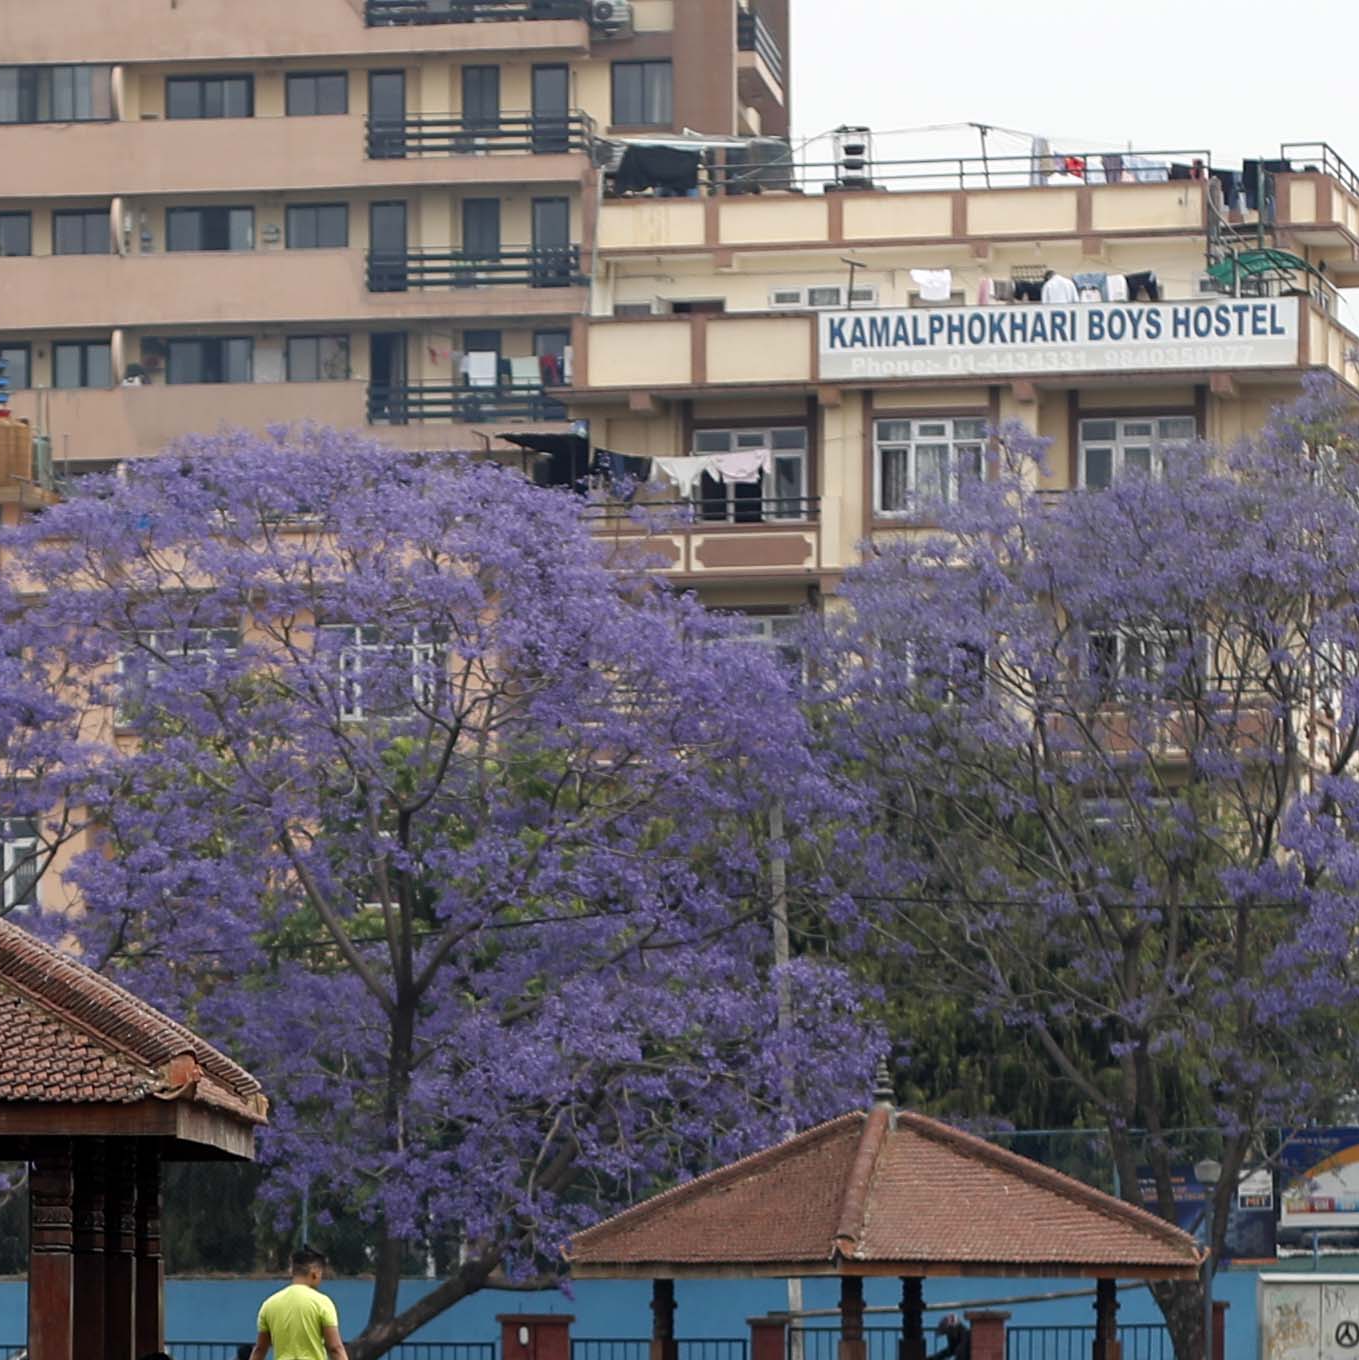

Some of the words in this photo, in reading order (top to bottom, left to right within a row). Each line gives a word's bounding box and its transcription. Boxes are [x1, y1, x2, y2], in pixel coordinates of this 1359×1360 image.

[828, 310, 1077, 349] KAMALPHOKHARI
[1088, 307, 1162, 341] BOYS
[1172, 304, 1286, 339] HOSTEL
